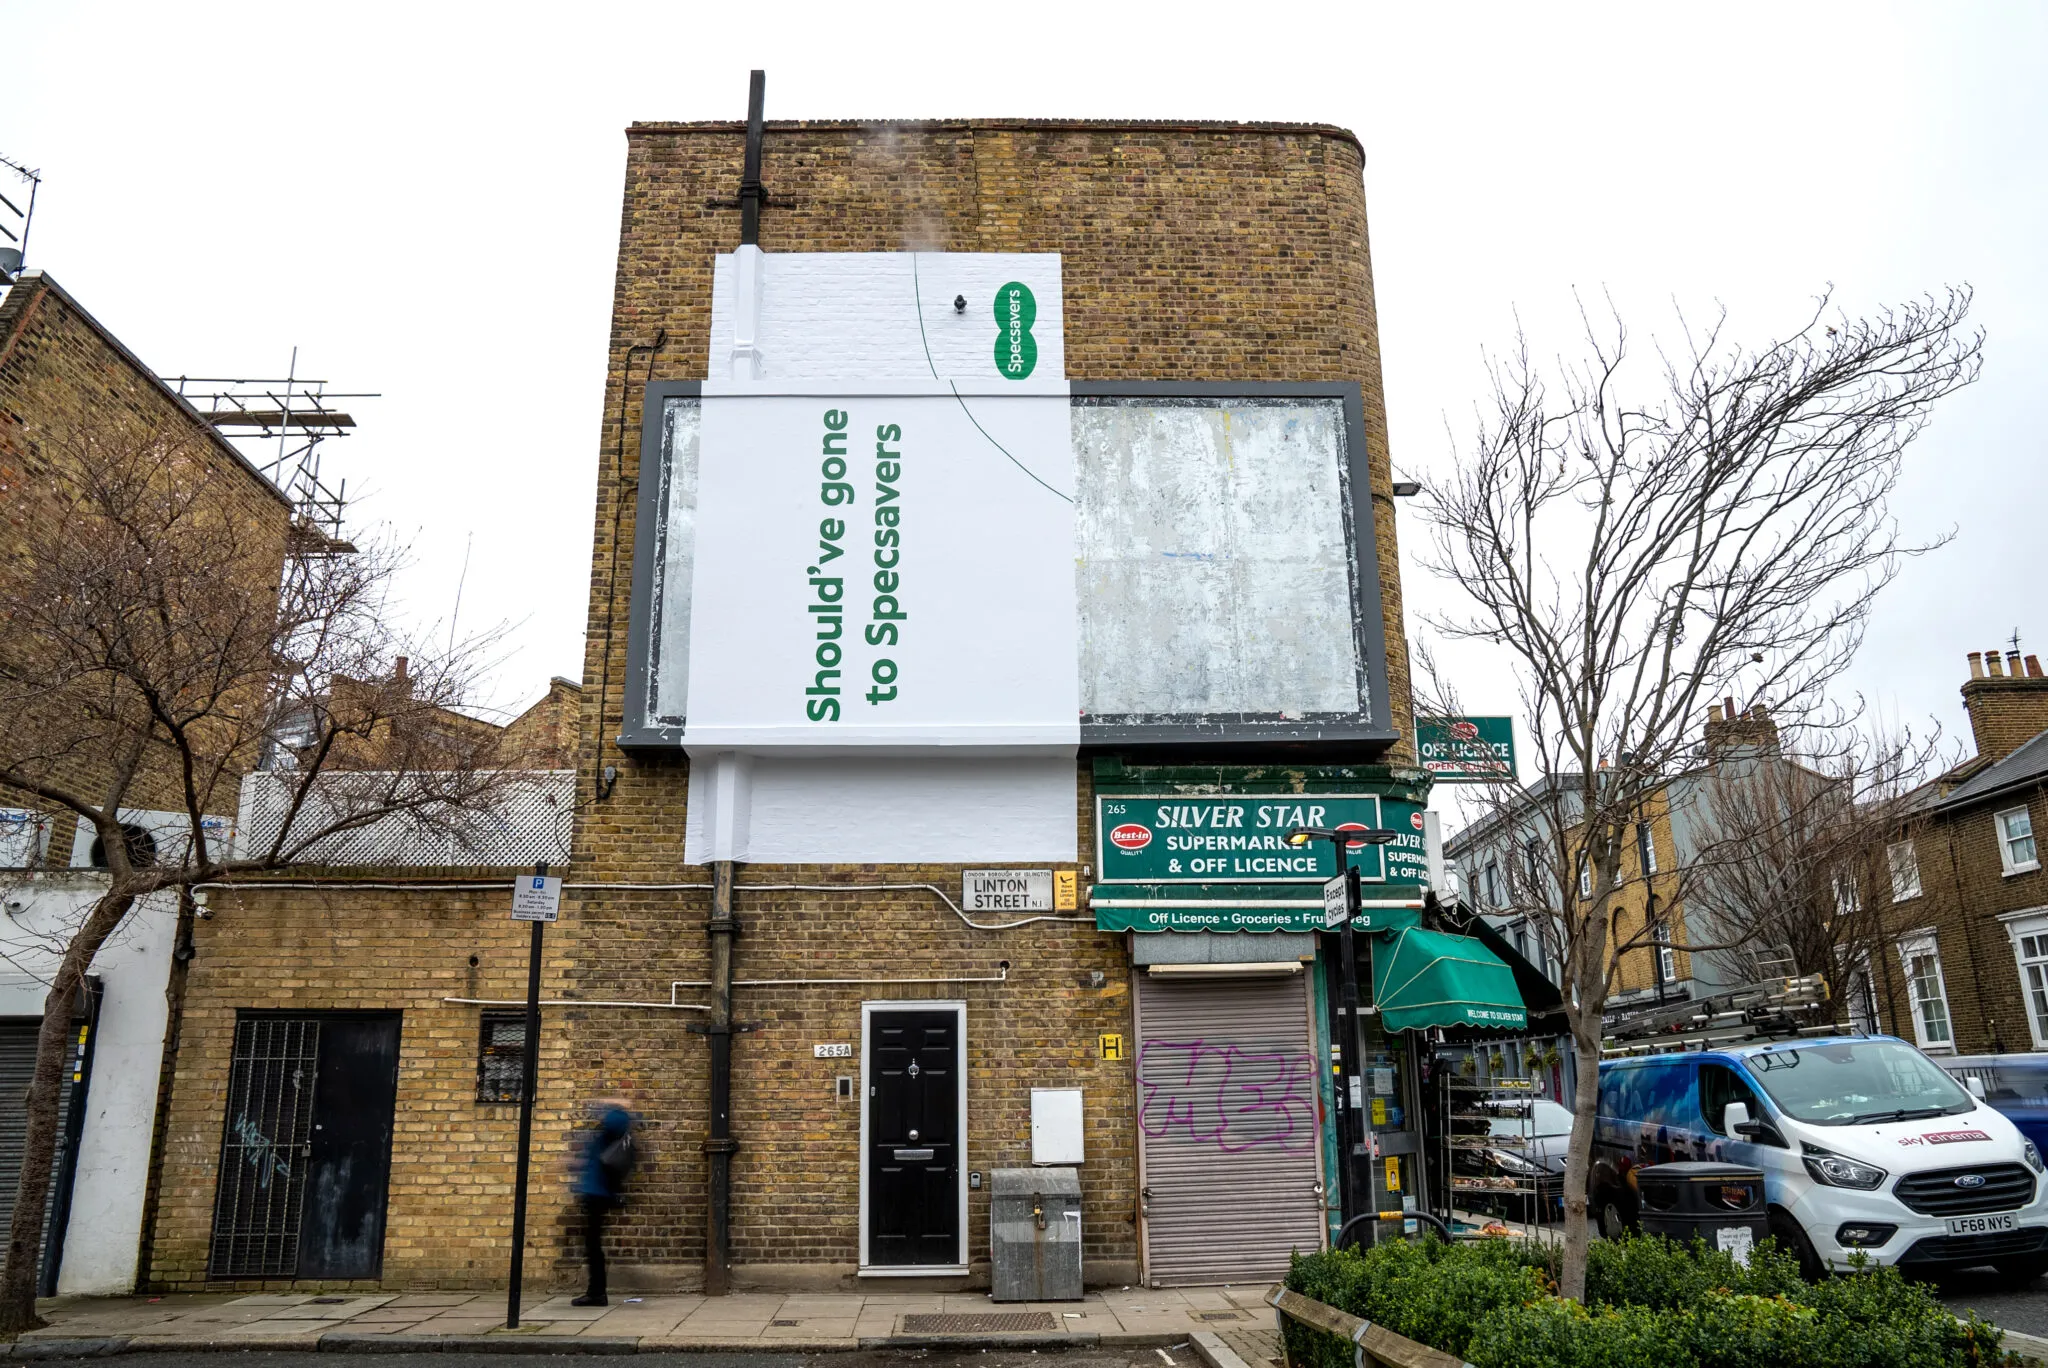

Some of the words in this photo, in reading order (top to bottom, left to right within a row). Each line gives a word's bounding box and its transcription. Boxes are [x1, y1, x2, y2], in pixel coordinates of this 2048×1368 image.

[1008, 289, 1024, 373] Specsavers
[820, 408, 855, 506] gone
[864, 422, 908, 646] Specsavers
[805, 517, 846, 722] Should've
[865, 658, 899, 706] to
[1427, 763, 1454, 771] OPEN
[1107, 804, 1126, 814] 265
[1155, 805, 1244, 828] SILVER
[1256, 805, 1326, 828] STAR
[1113, 831, 1149, 840] Best-in
[1168, 858, 1182, 873] &
[1190, 858, 1227, 873] OFF
[1234, 857, 1317, 873] LICENCE
[1390, 866, 1398, 877] &
[1401, 867, 1417, 878] OFF
[974, 879, 1027, 893] LINTON
[1326, 882, 1344, 903] Except
[975, 894, 1030, 908] STREET
[1149, 913, 1168, 924] Off
[1172, 913, 1220, 924] Licence
[1231, 913, 1292, 924] Groceries
[1328, 903, 1344, 921] cycles
[1467, 1009, 1490, 1019] WELCOME
[1489, 1011, 1496, 1019] TO
[1496, 1011, 1512, 1021] SILVER
[1511, 1013, 1524, 1022] STAR
[819, 1045, 850, 1057] 265A
[1103, 1037, 1119, 1059] H
[1898, 1137, 1924, 1146] sky
[1928, 1132, 1986, 1143] cinema
[1963, 1176, 1980, 1186] Ford
[1952, 1218, 1986, 1233] LF68
[1988, 1216, 2012, 1230] NYS
